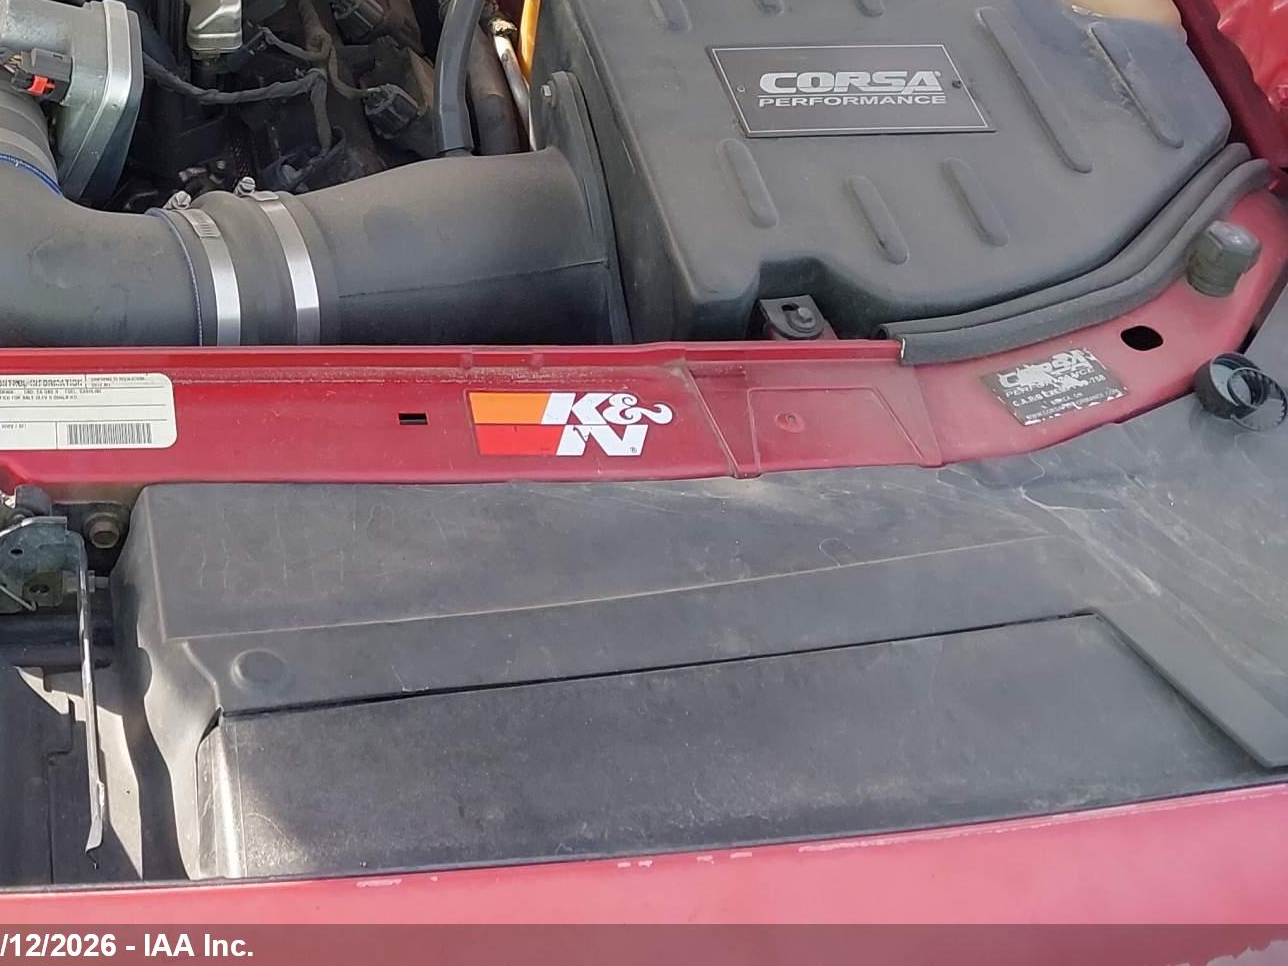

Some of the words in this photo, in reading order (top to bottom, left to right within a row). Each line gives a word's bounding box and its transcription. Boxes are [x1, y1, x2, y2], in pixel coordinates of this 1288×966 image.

[759, 70, 943, 94] CORSA
[759, 95, 947, 107] PERFORMANCE
[29, 378, 83, 387] INFORMATION
